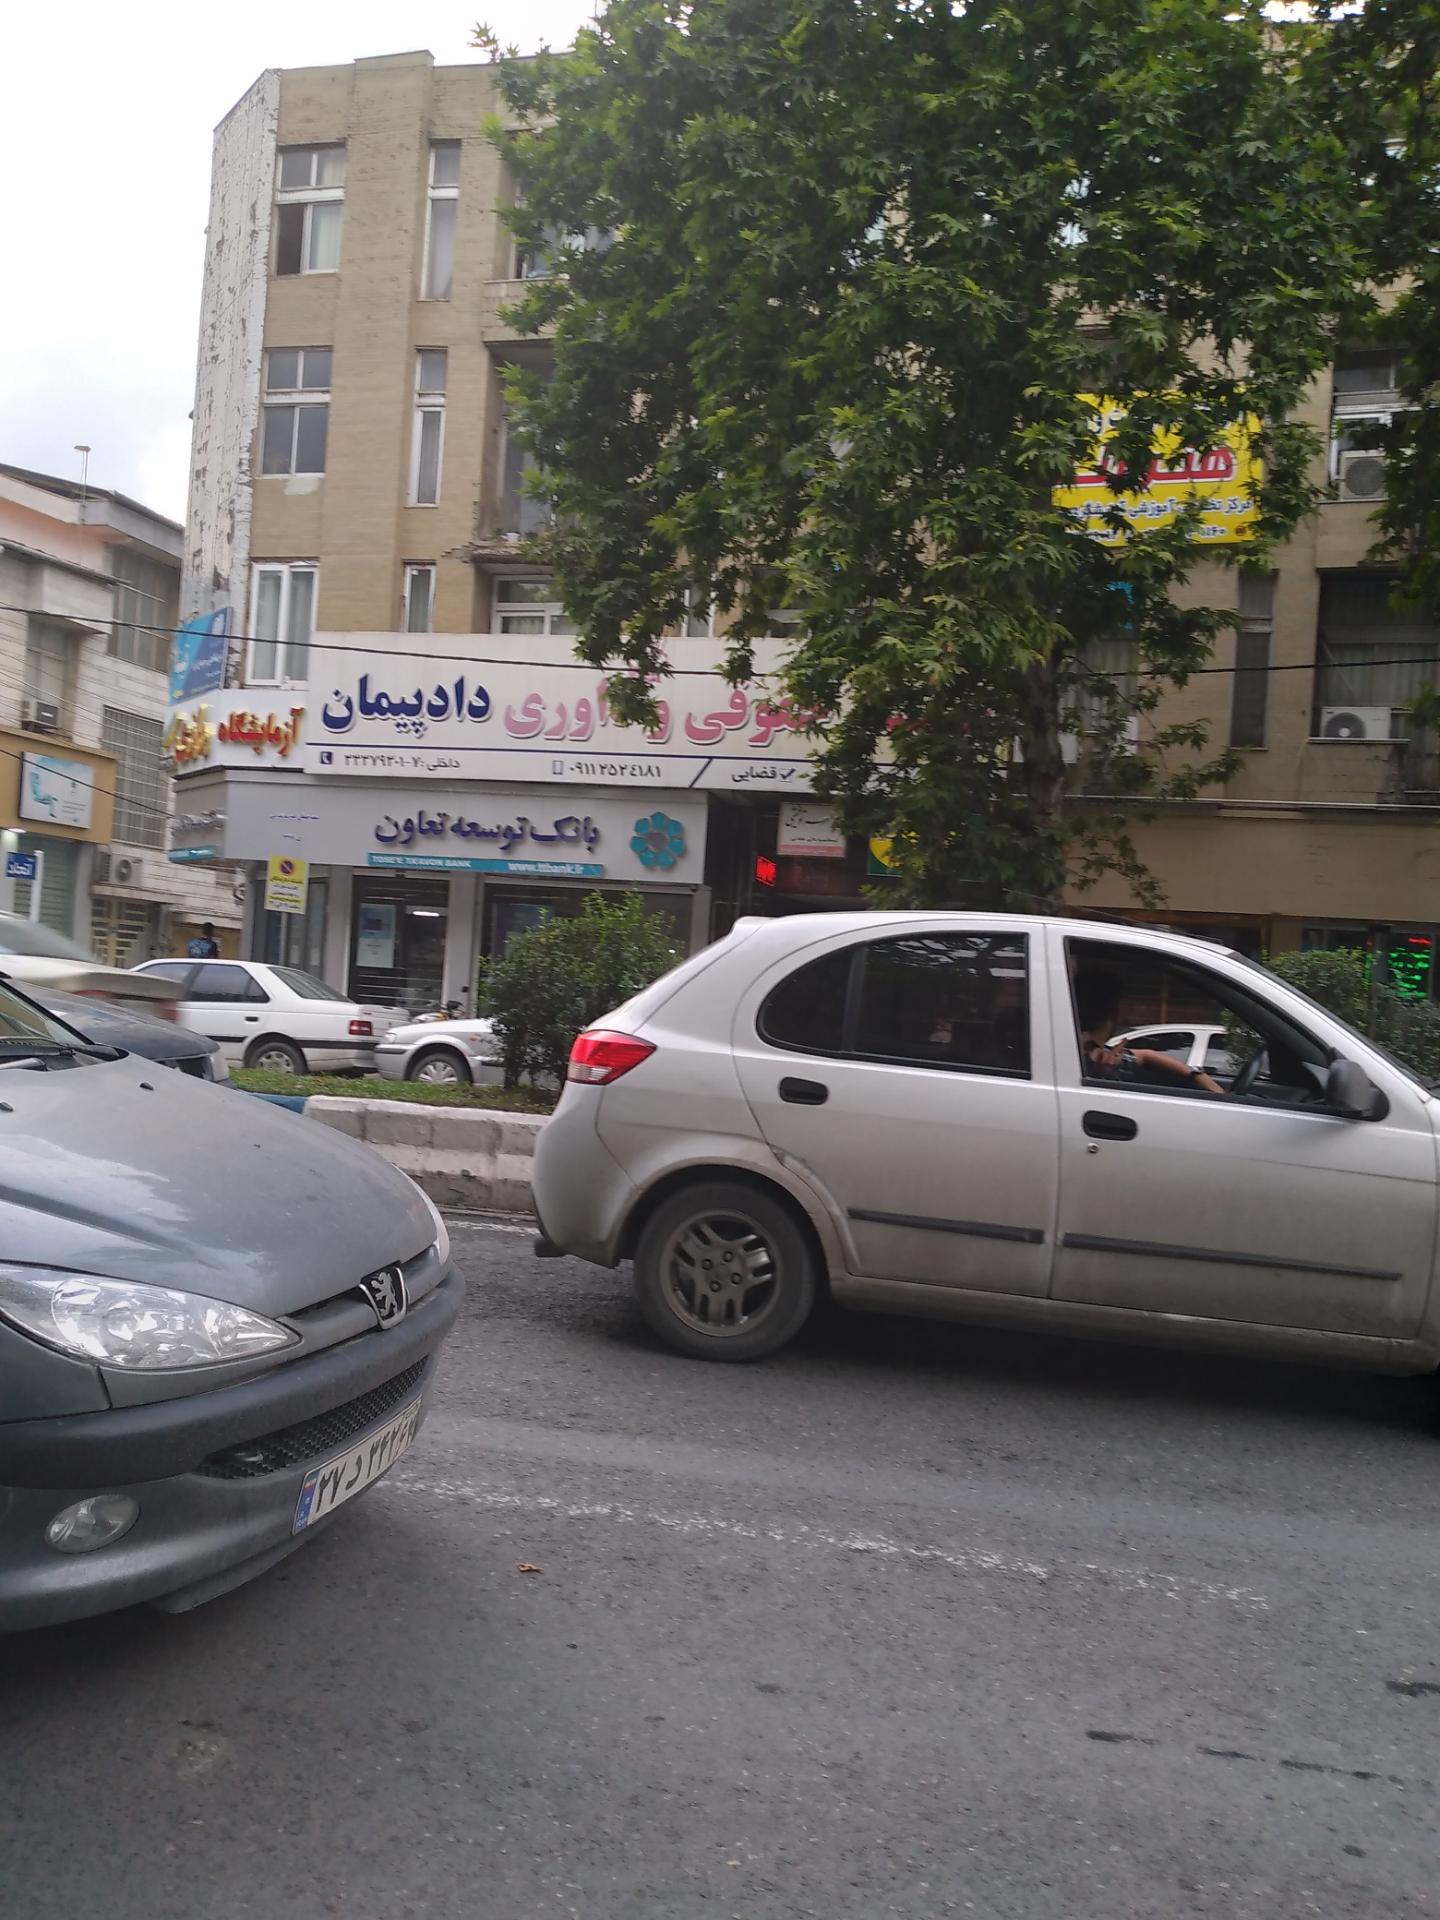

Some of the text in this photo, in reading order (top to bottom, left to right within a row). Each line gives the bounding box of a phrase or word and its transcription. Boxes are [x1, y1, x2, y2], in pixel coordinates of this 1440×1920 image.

[732, 766, 778, 782] قضایی
[375, 809, 600, 854] بانک توسعه تعاون
[316, 1461, 347, 1513] ۲۷
[345, 1454, 363, 1491] د
